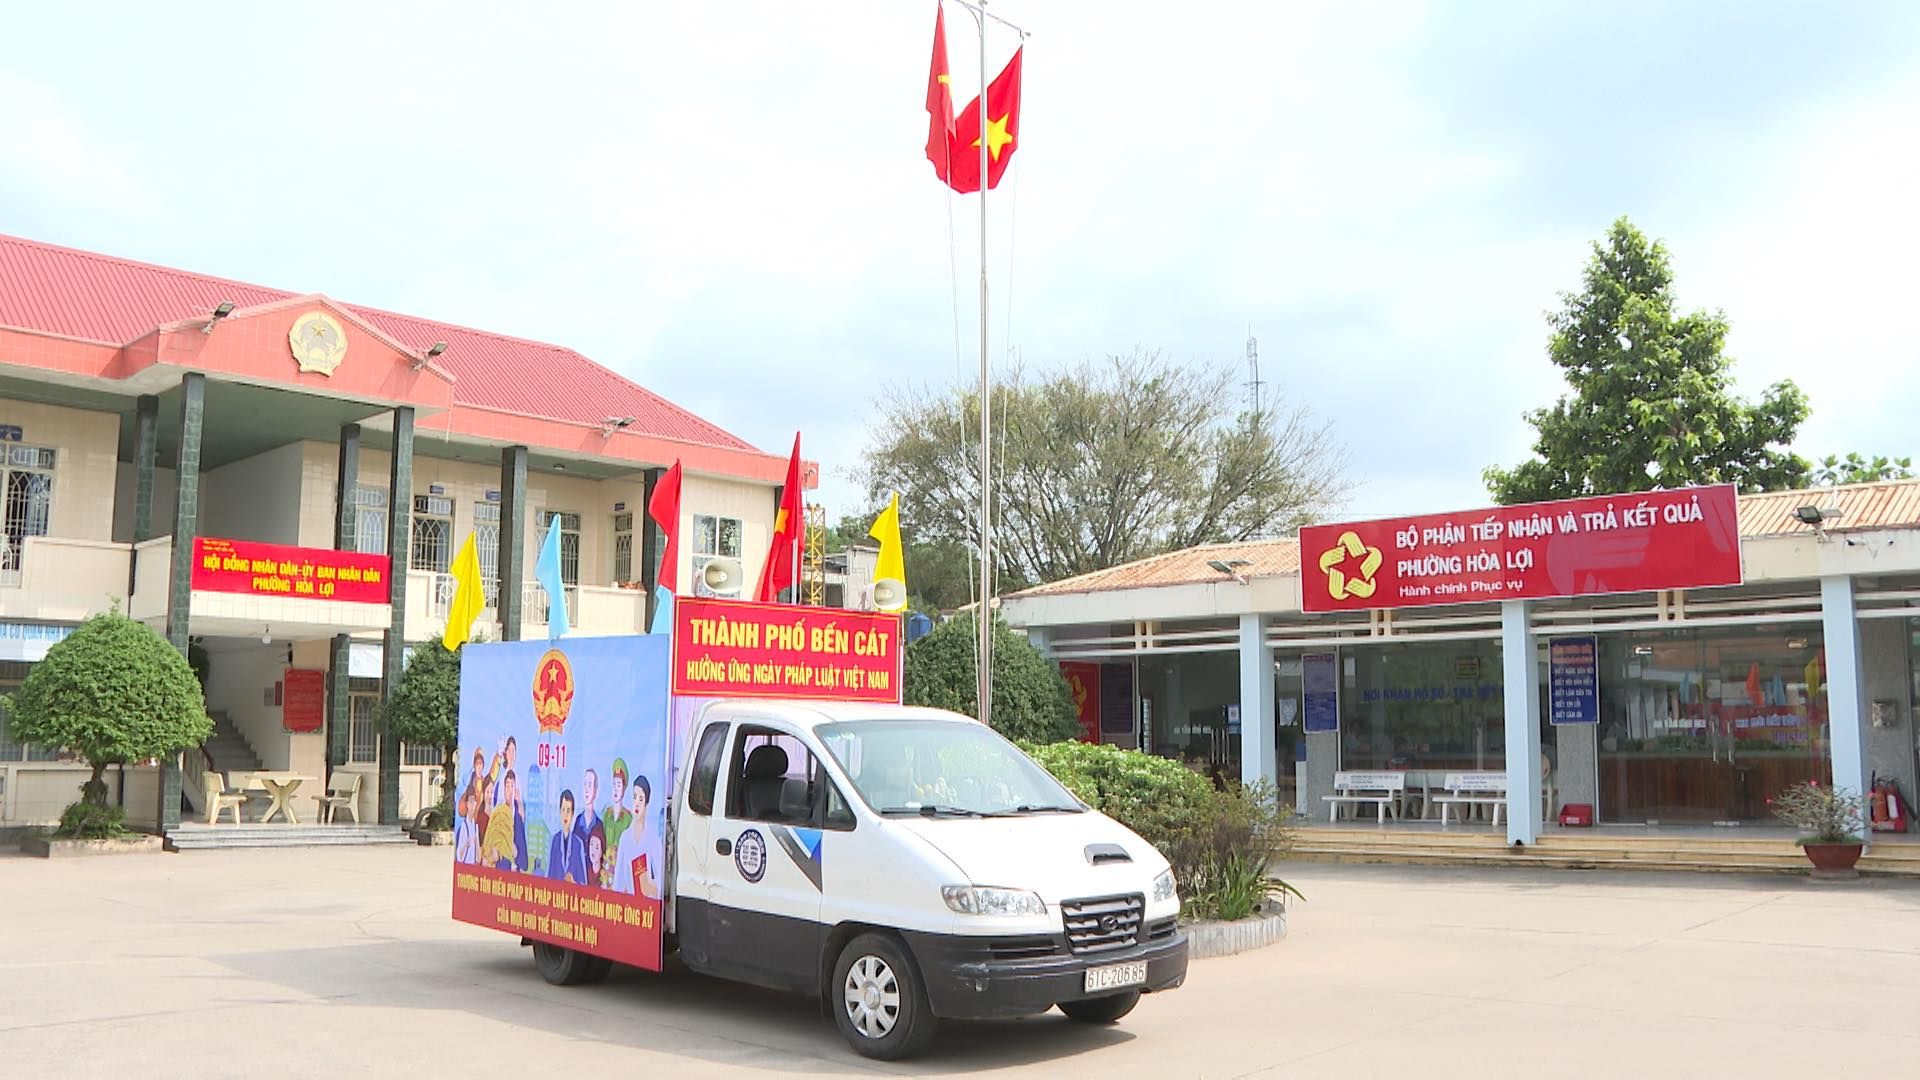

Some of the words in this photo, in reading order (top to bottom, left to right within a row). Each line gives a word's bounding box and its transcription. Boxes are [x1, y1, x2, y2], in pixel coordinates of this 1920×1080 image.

[1395, 524, 1419, 551] BỘ
[1423, 521, 1466, 548] PHẬN
[1469, 515, 1504, 541] TIẾP
[1508, 513, 1553, 540] NHẬN
[1557, 510, 1579, 534] VÀ
[1581, 503, 1618, 532] TRẢ
[1623, 500, 1659, 528] KẾT
[1663, 494, 1704, 524] QUẢ
[203, 553, 221, 573] HỘI
[223, 554, 250, 572] ĐỒNG
[251, 558, 277, 574] NHÂN
[317, 566, 336, 580] BAN
[337, 565, 361, 582] NHÂN
[363, 567, 381, 583] DÂN
[1397, 553, 1463, 578] PHƯỜNG
[1466, 548, 1501, 573] HÒA
[1506, 547, 1534, 573] LỢI
[252, 574, 291, 593] PHƯỜNG
[295, 577, 315, 594] HÒA
[319, 581, 335, 598] LỢI
[1399, 584, 1431, 598] Hành
[1434, 582, 1467, 595] chính
[1470, 580, 1503, 594] Phục
[1506, 579, 1524, 592] vụ
[689, 615, 760, 649] THÀNH
[765, 617, 807, 652] PHỐ
[810, 621, 849, 655] BẾN
[854, 627, 890, 657] CÁT
[686, 653, 726, 683] HƯỞNG
[727, 657, 751, 684] ỨNG
[753, 659, 782, 685] NGÀY
[784, 661, 813, 687] PHÁP
[815, 664, 841, 690] LUẬT
[843, 664, 865, 692] VIỆT
[867, 670, 890, 690] NAM
[538, 743, 567, 768] 09-11
[506, 881, 524, 901] PHÁP
[524, 883, 533, 903] VÀ
[533, 885, 552, 906] PHÁP
[552, 890, 569, 914] LUẬT
[570, 892, 579, 914] LÀ
[605, 903, 623, 926] MỰC
[623, 903, 641, 926] ỨNG
[641, 905, 655, 930] XỬ
[551, 919, 573, 940] TRONG
[584, 924, 598, 949] HỘI
